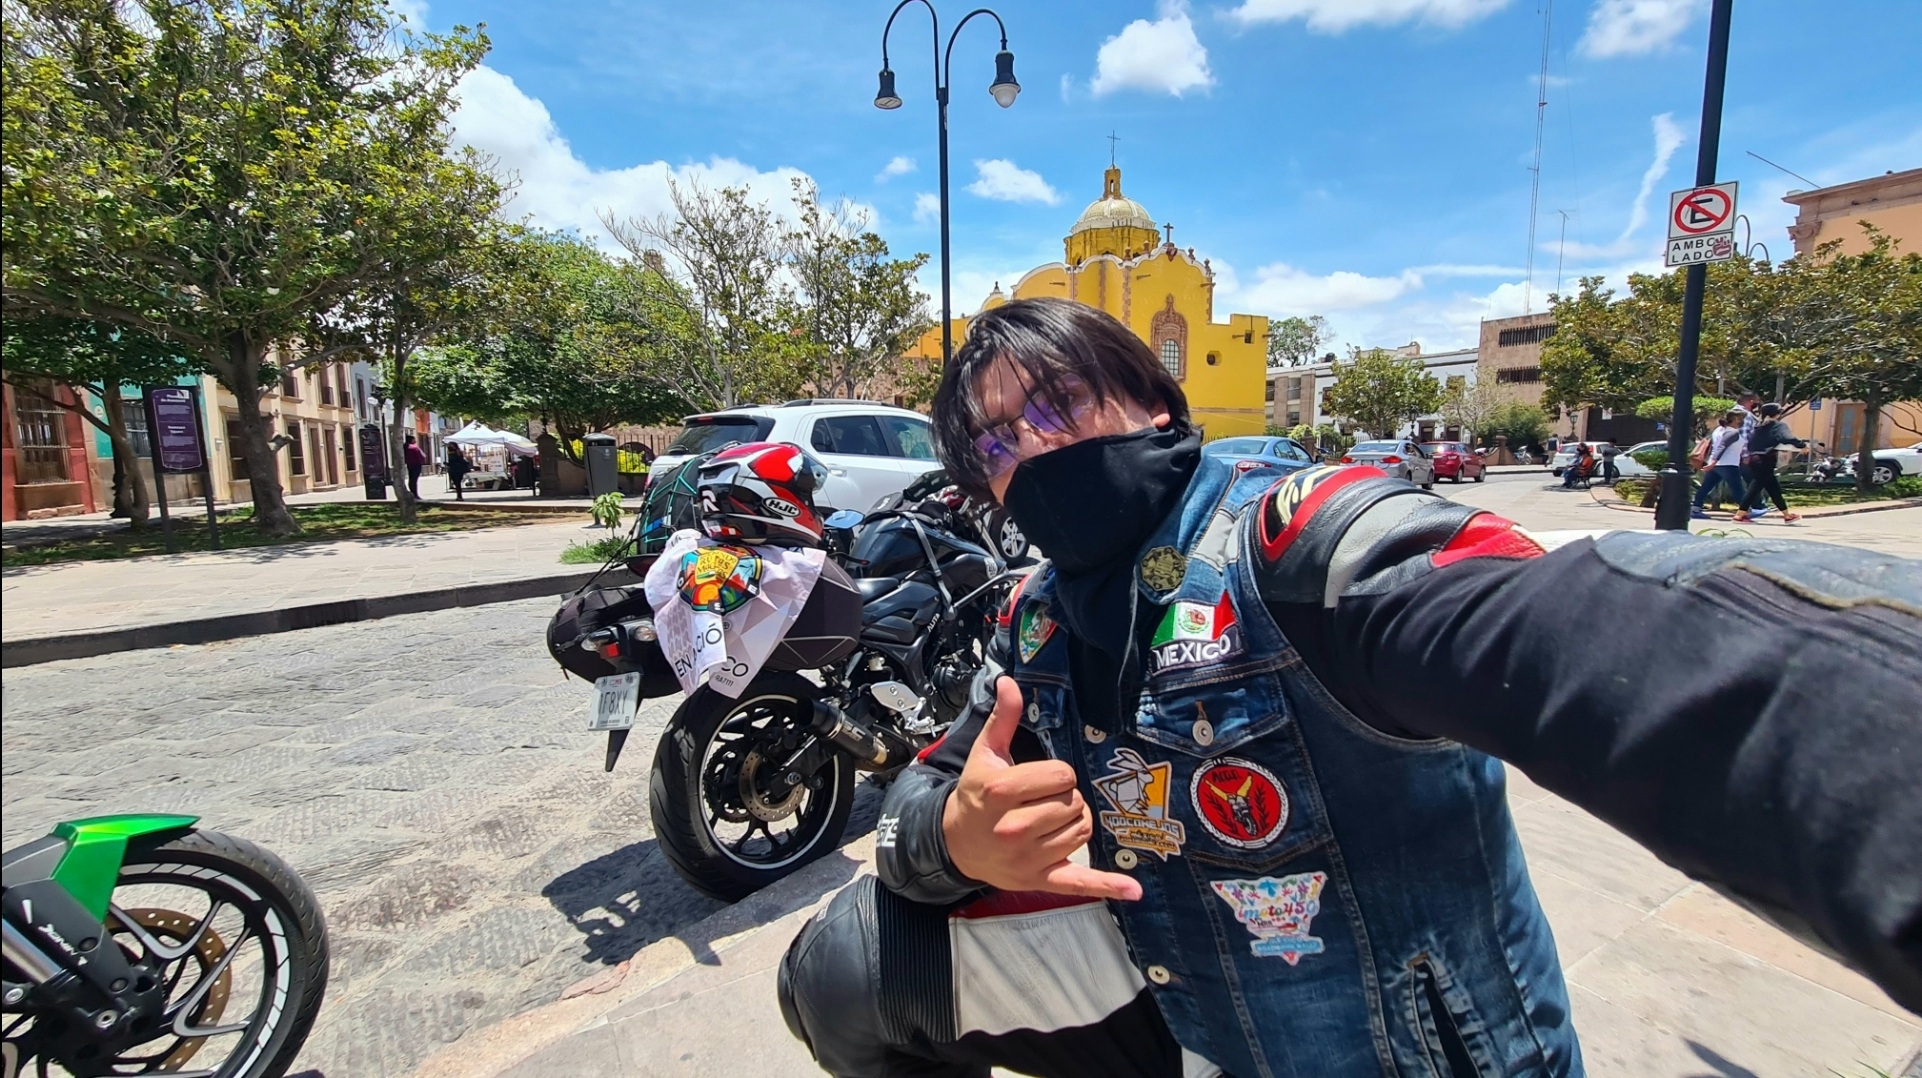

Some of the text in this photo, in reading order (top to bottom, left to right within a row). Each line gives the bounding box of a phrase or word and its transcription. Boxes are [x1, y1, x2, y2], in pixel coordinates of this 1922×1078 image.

[1672, 237, 1716, 252] AMBO
[1672, 249, 1714, 264] LADO
[768, 499, 798, 515] HJC
[1152, 634, 1231, 670] MEXICO
